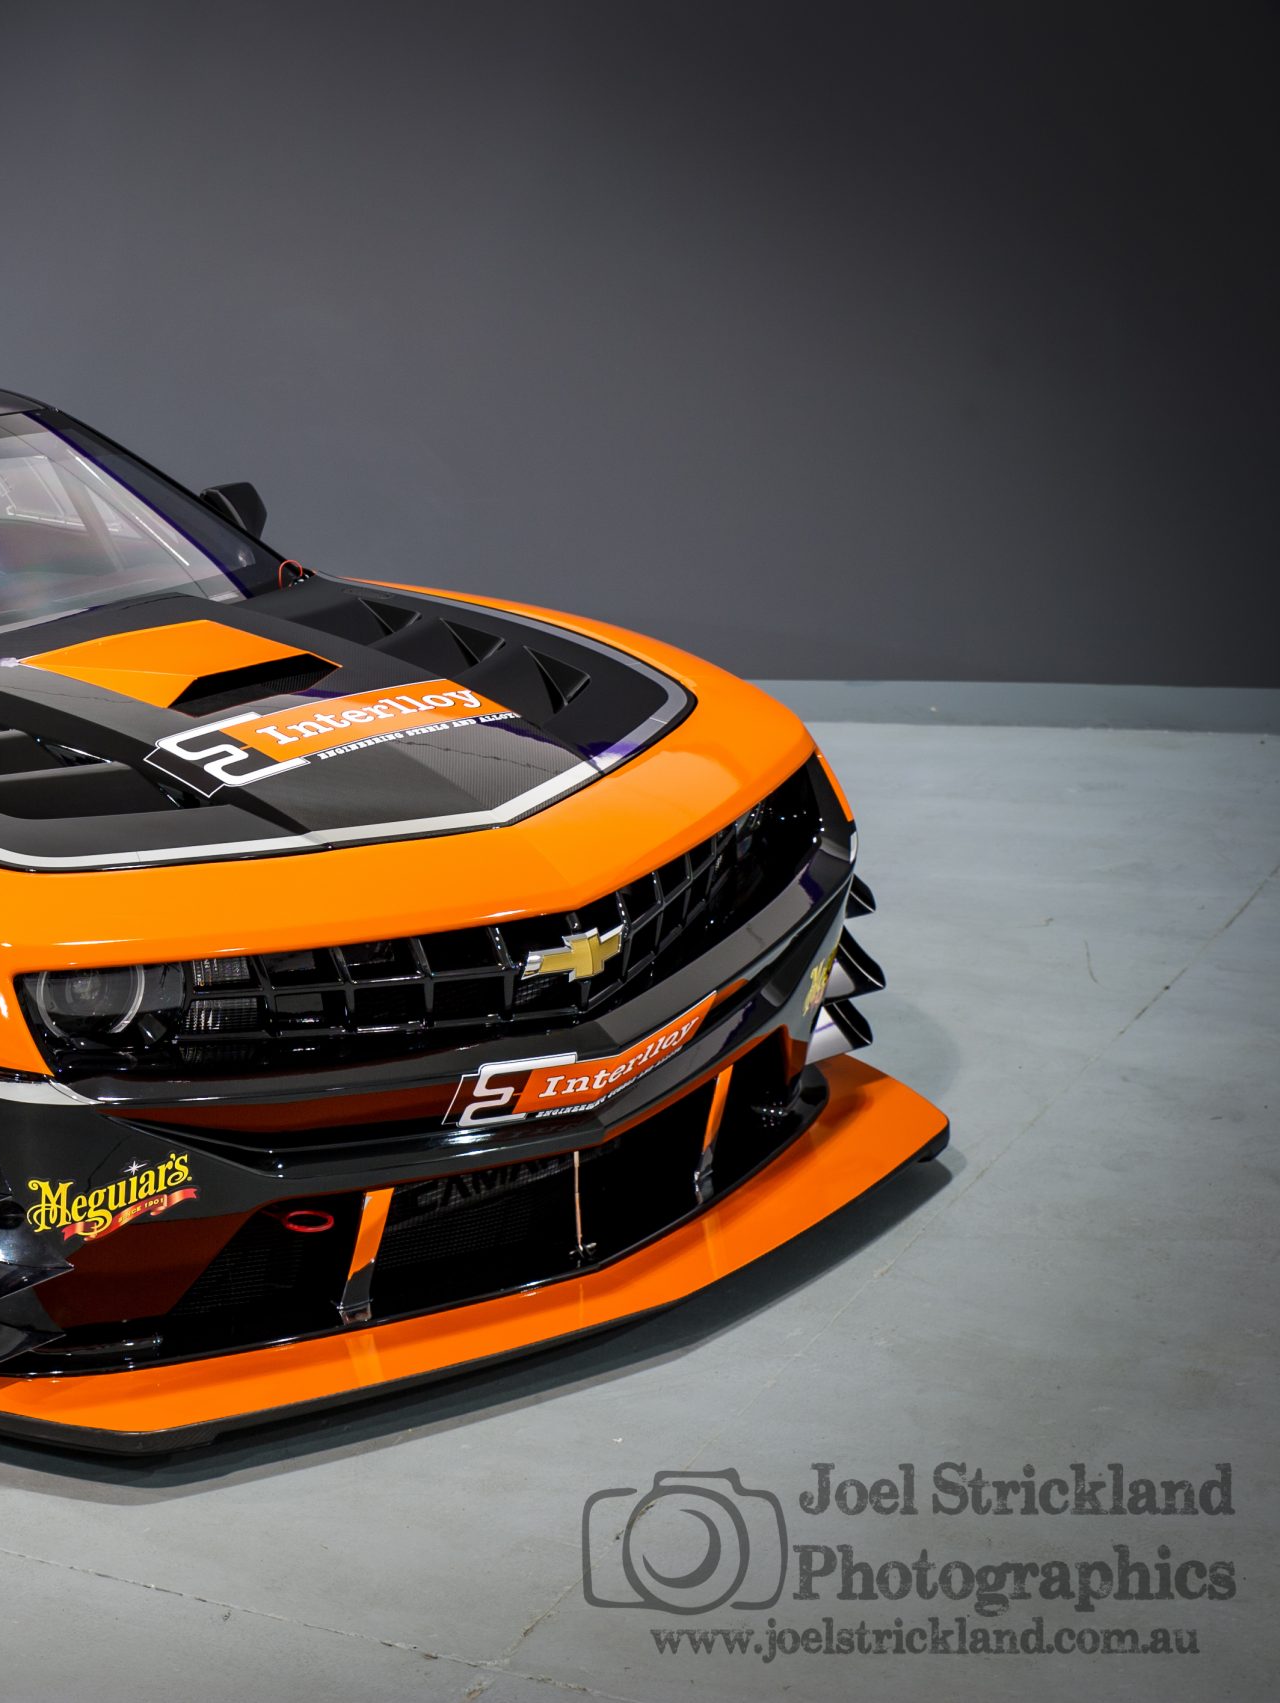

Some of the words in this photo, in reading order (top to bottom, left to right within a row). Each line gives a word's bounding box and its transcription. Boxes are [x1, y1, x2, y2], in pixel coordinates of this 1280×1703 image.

[255, 687, 484, 746] Interlloy
[317, 733, 405, 760] ENGINEERING
[405, 723, 450, 738] STEELS
[452, 717, 478, 729] AND
[538, 1015, 700, 1099] Interlloy
[26, 1152, 192, 1236] Meguiar's
